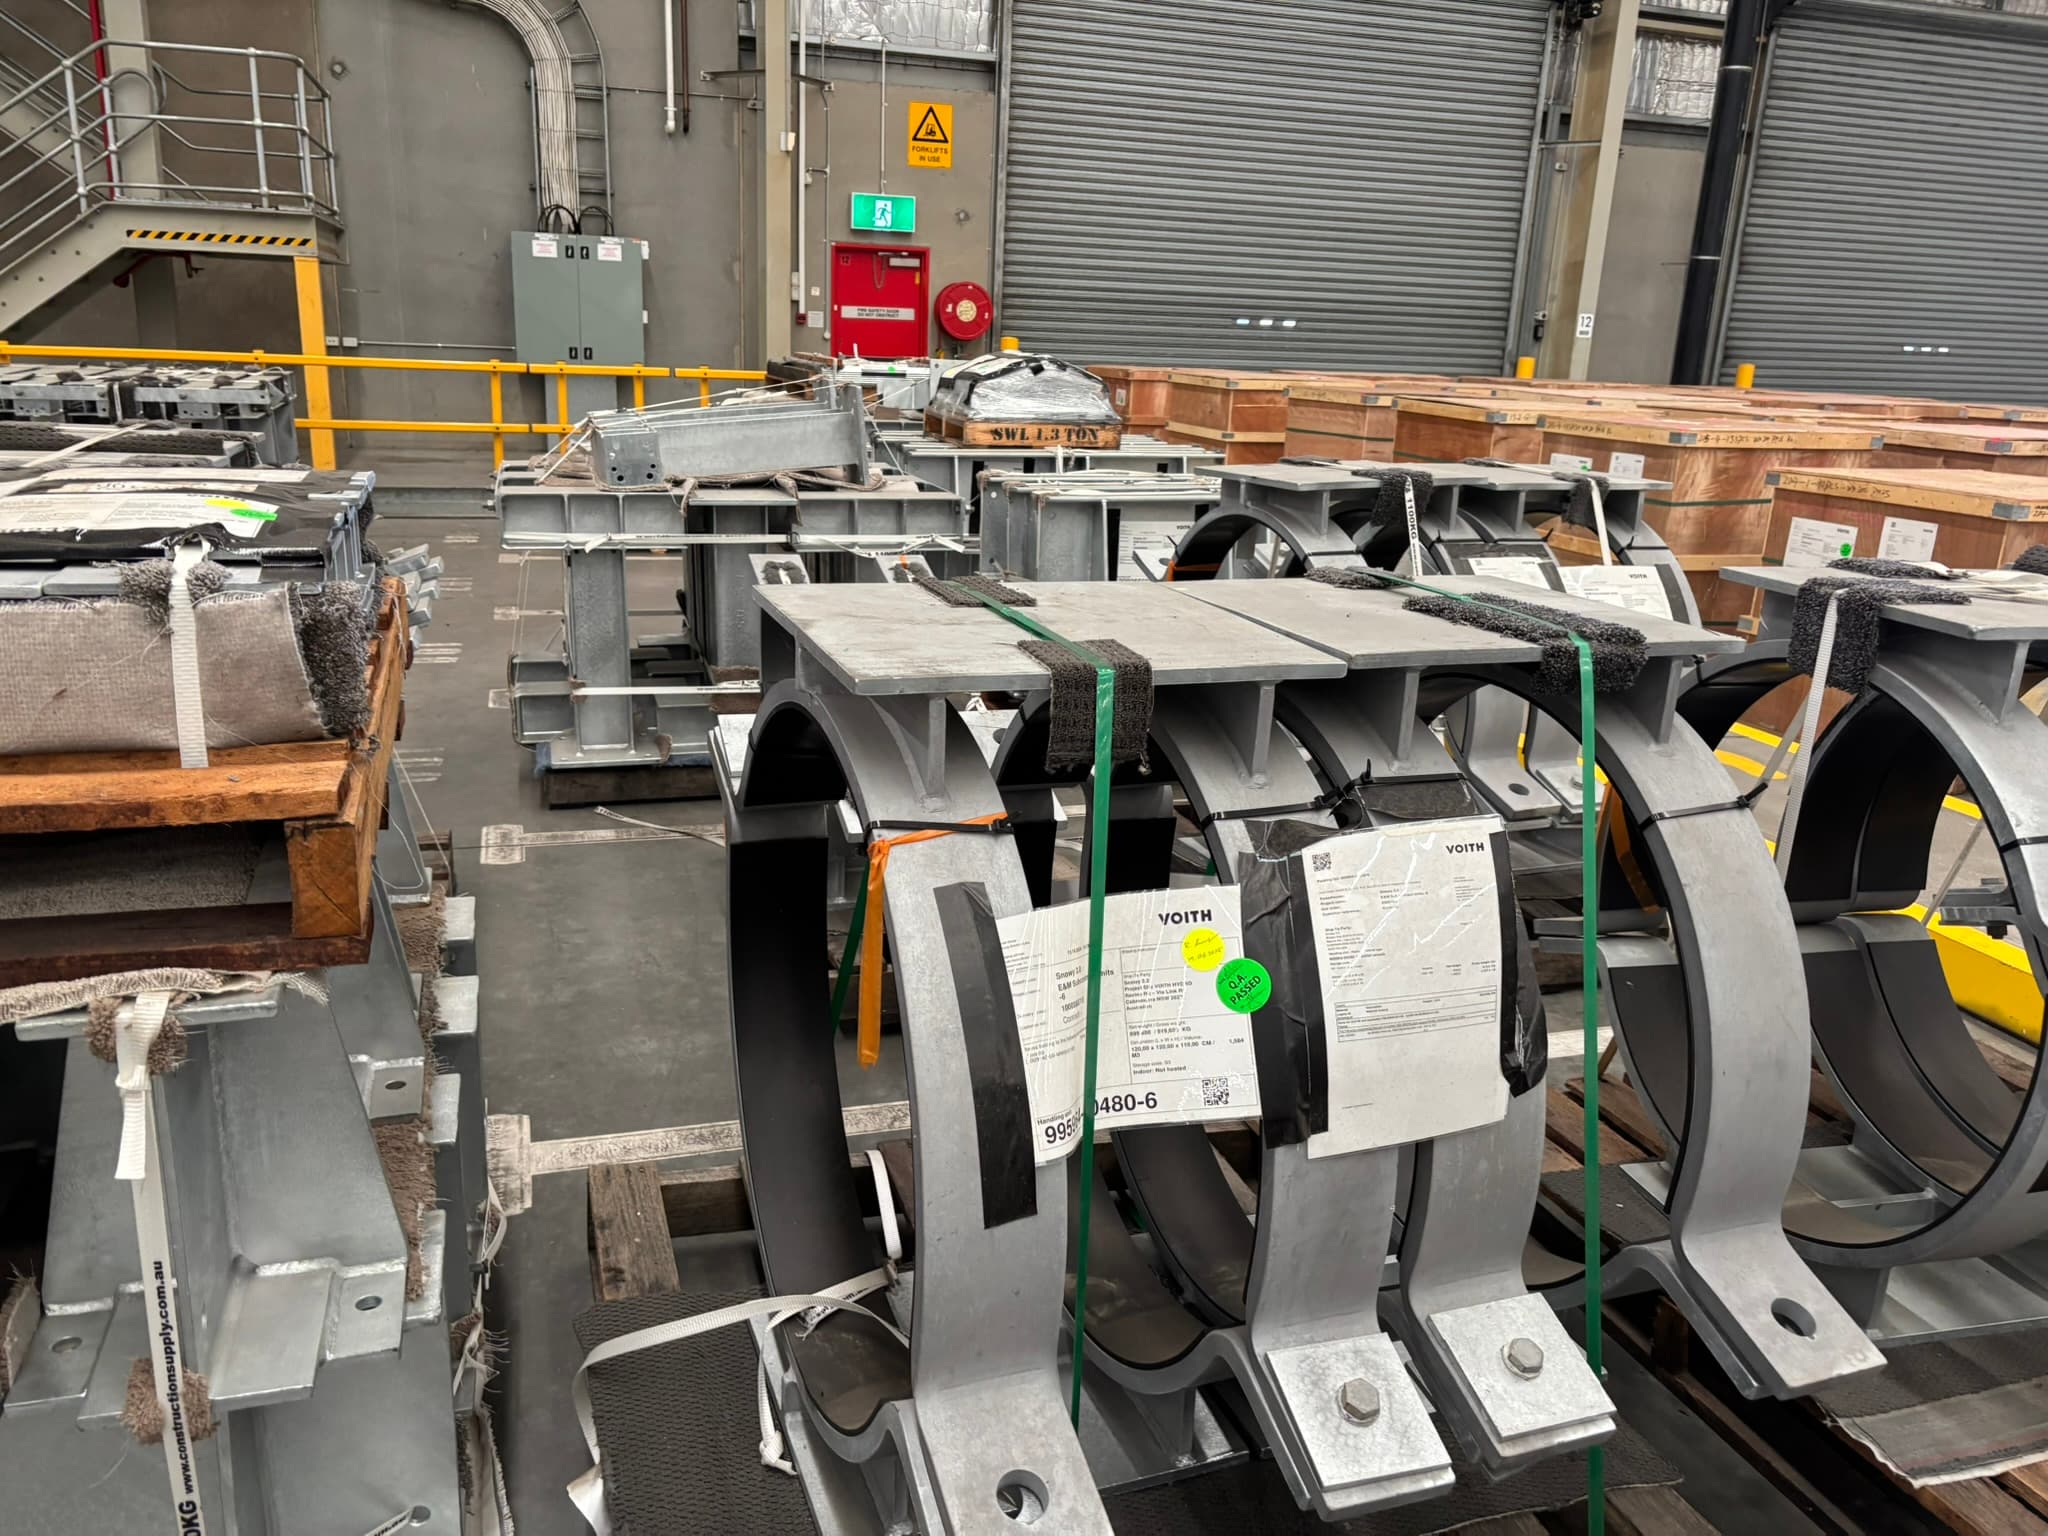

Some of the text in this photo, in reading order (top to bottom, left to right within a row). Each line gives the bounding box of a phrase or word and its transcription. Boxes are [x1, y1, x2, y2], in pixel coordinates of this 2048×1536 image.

[912, 145, 949, 154] FORKLIFTS
[1581, 316, 1592, 327] 12
[991, 428, 1099, 441] SWL 1.3 TON
[1407, 498, 1418, 540] 1100KG
[1446, 842, 1485, 854] VOITH
[1158, 909, 1213, 925] VOITH
[1055, 971, 1075, 980] Snowy
[1228, 974, 1247, 990] Q.A.
[1058, 981, 1072, 991] E&M
[1230, 975, 1262, 1005] PASSED
[1037, 1113, 1065, 1126] Handling
[152, 1261, 194, 1495] www.constructionsupply.com.au
